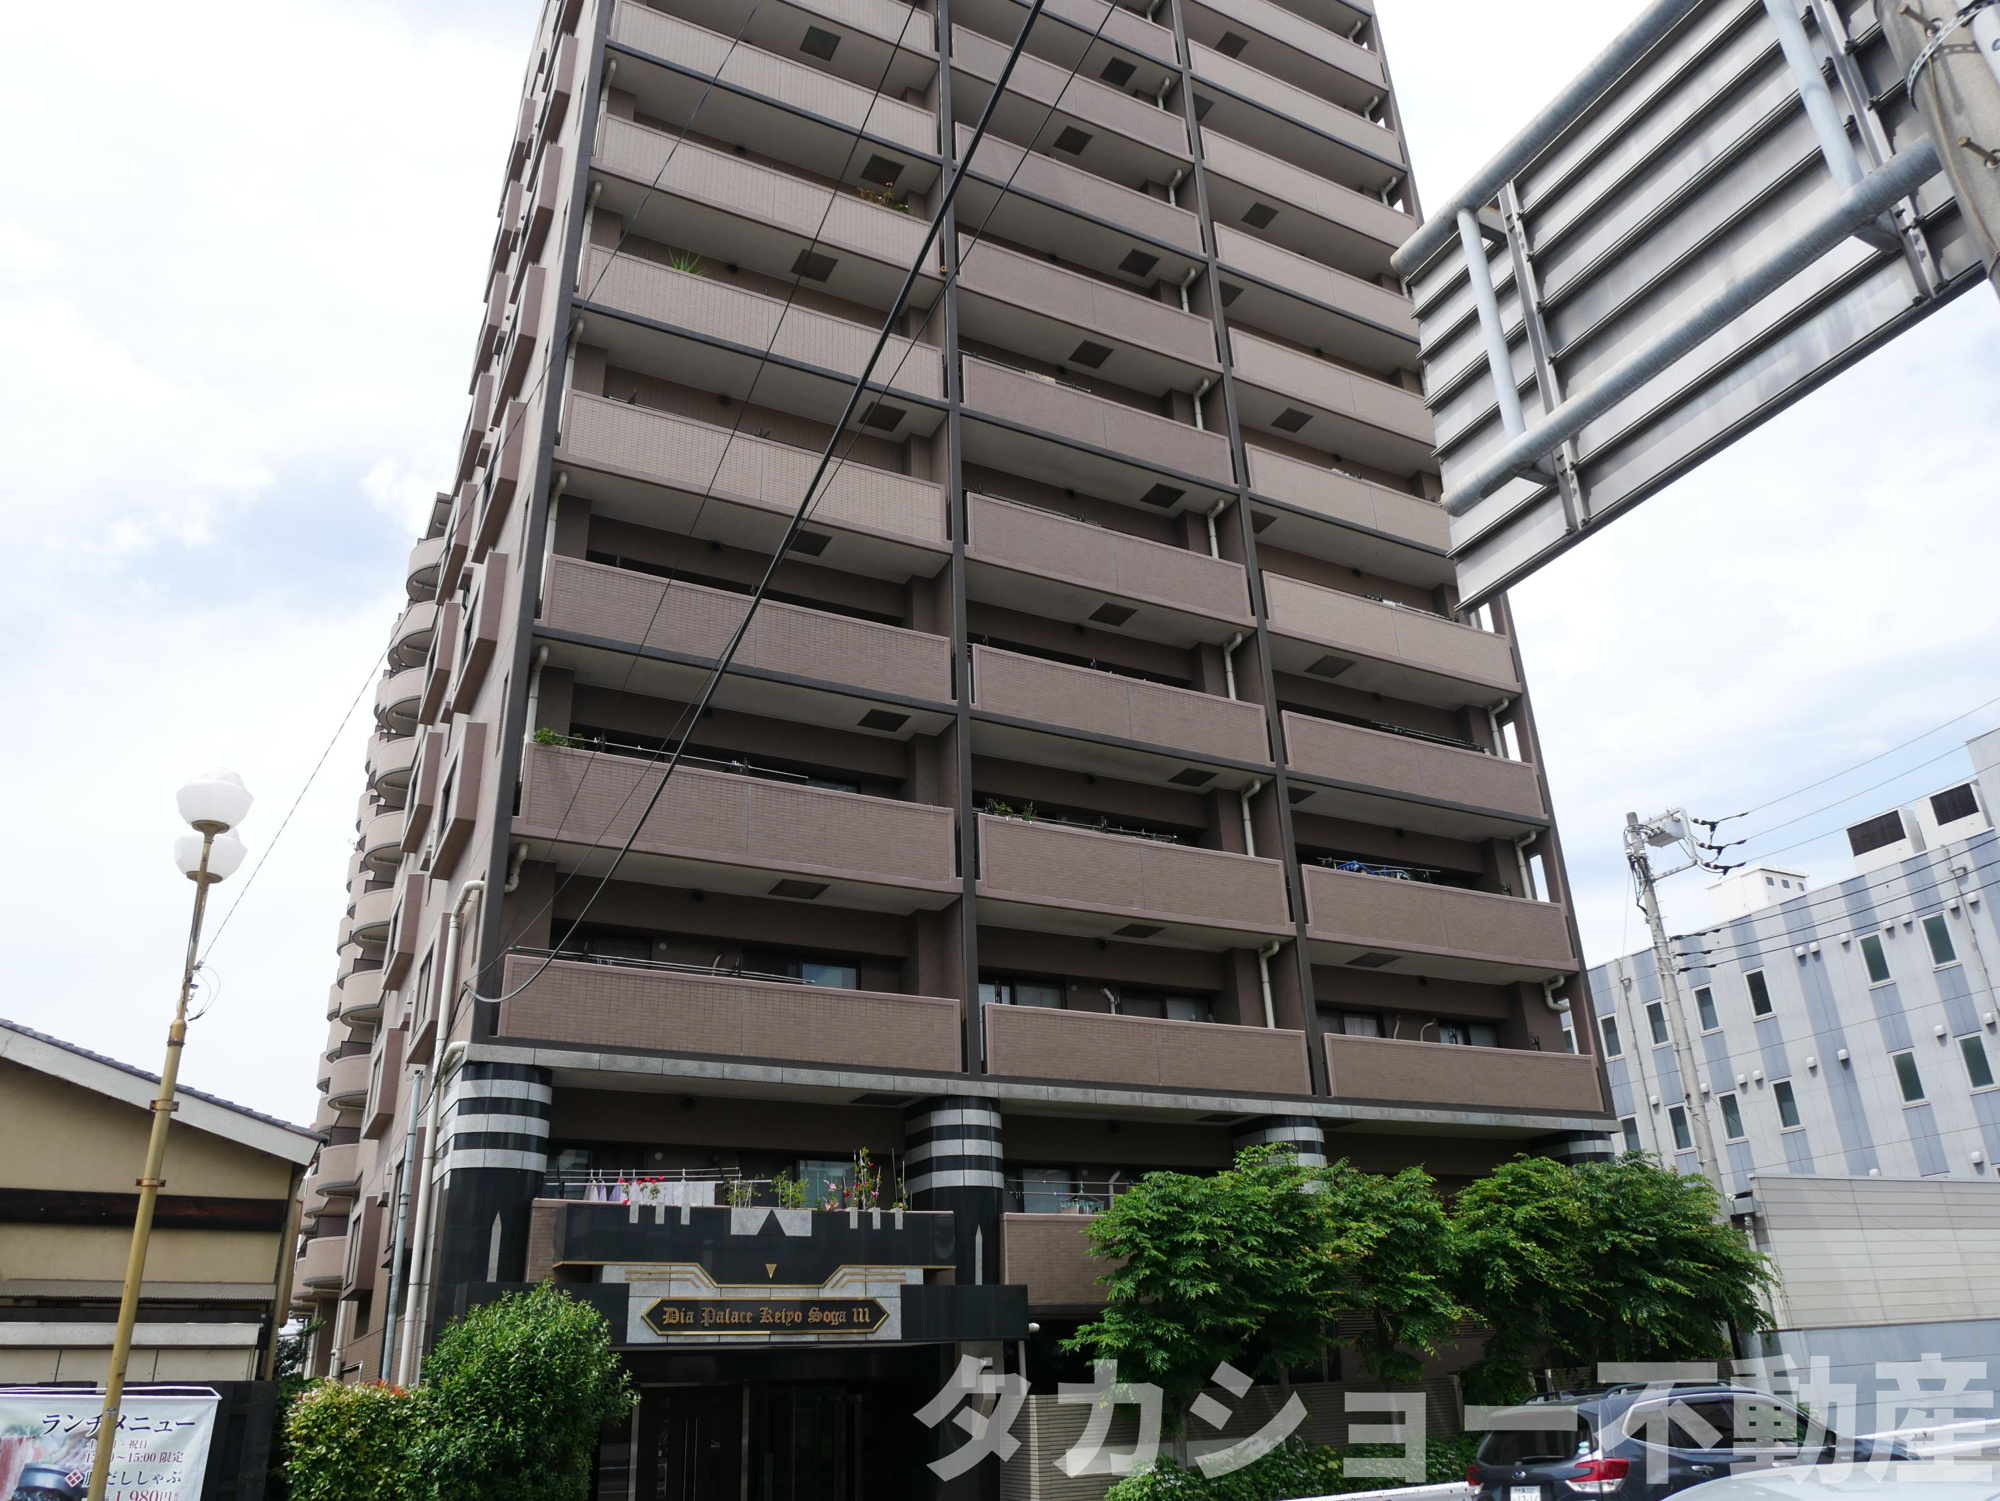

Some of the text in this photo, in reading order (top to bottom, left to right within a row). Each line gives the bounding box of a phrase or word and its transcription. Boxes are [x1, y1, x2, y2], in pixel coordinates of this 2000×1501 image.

[663, 1307, 694, 1324] Dia
[700, 1306, 753, 1327] Palace
[808, 1307, 847, 1325] Soga
